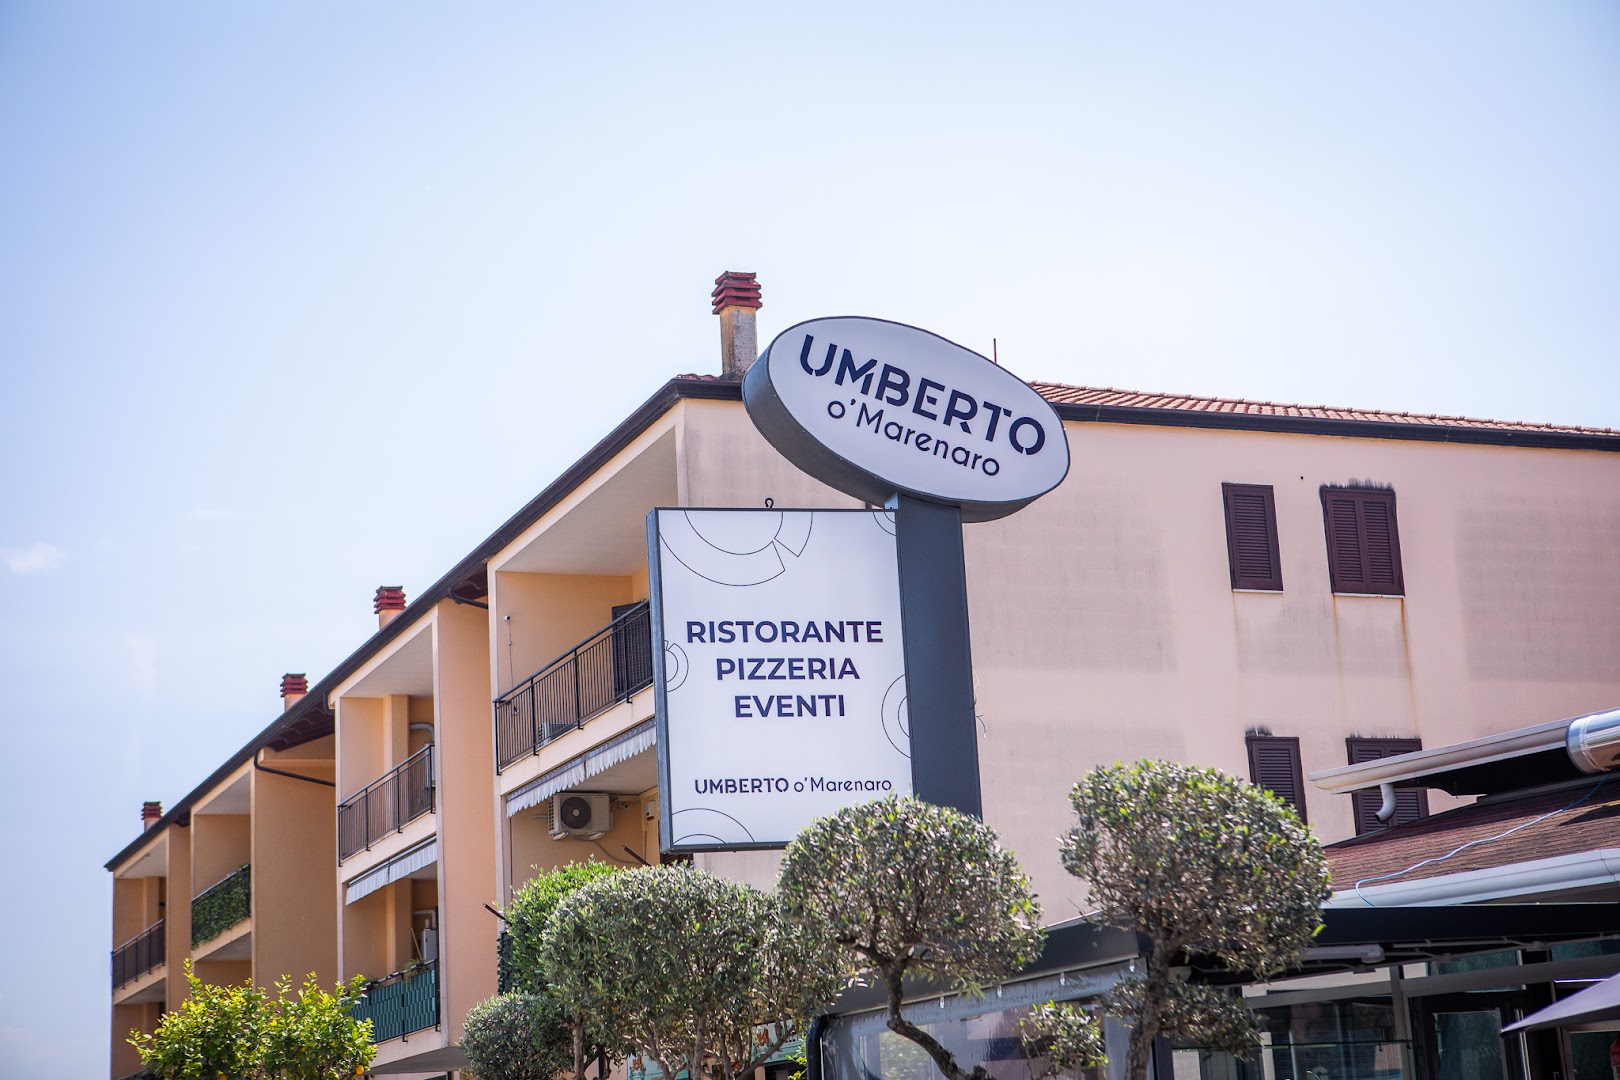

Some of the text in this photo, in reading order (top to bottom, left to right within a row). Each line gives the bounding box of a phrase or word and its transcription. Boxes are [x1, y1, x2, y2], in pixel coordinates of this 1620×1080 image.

[799, 333, 1046, 456] UMBERTO
[686, 620, 884, 644] RISTORANTE
[716, 657, 861, 681] PIZZERIA
[734, 694, 845, 718] EVENTI
[694, 777, 790, 795] UMBERTO
